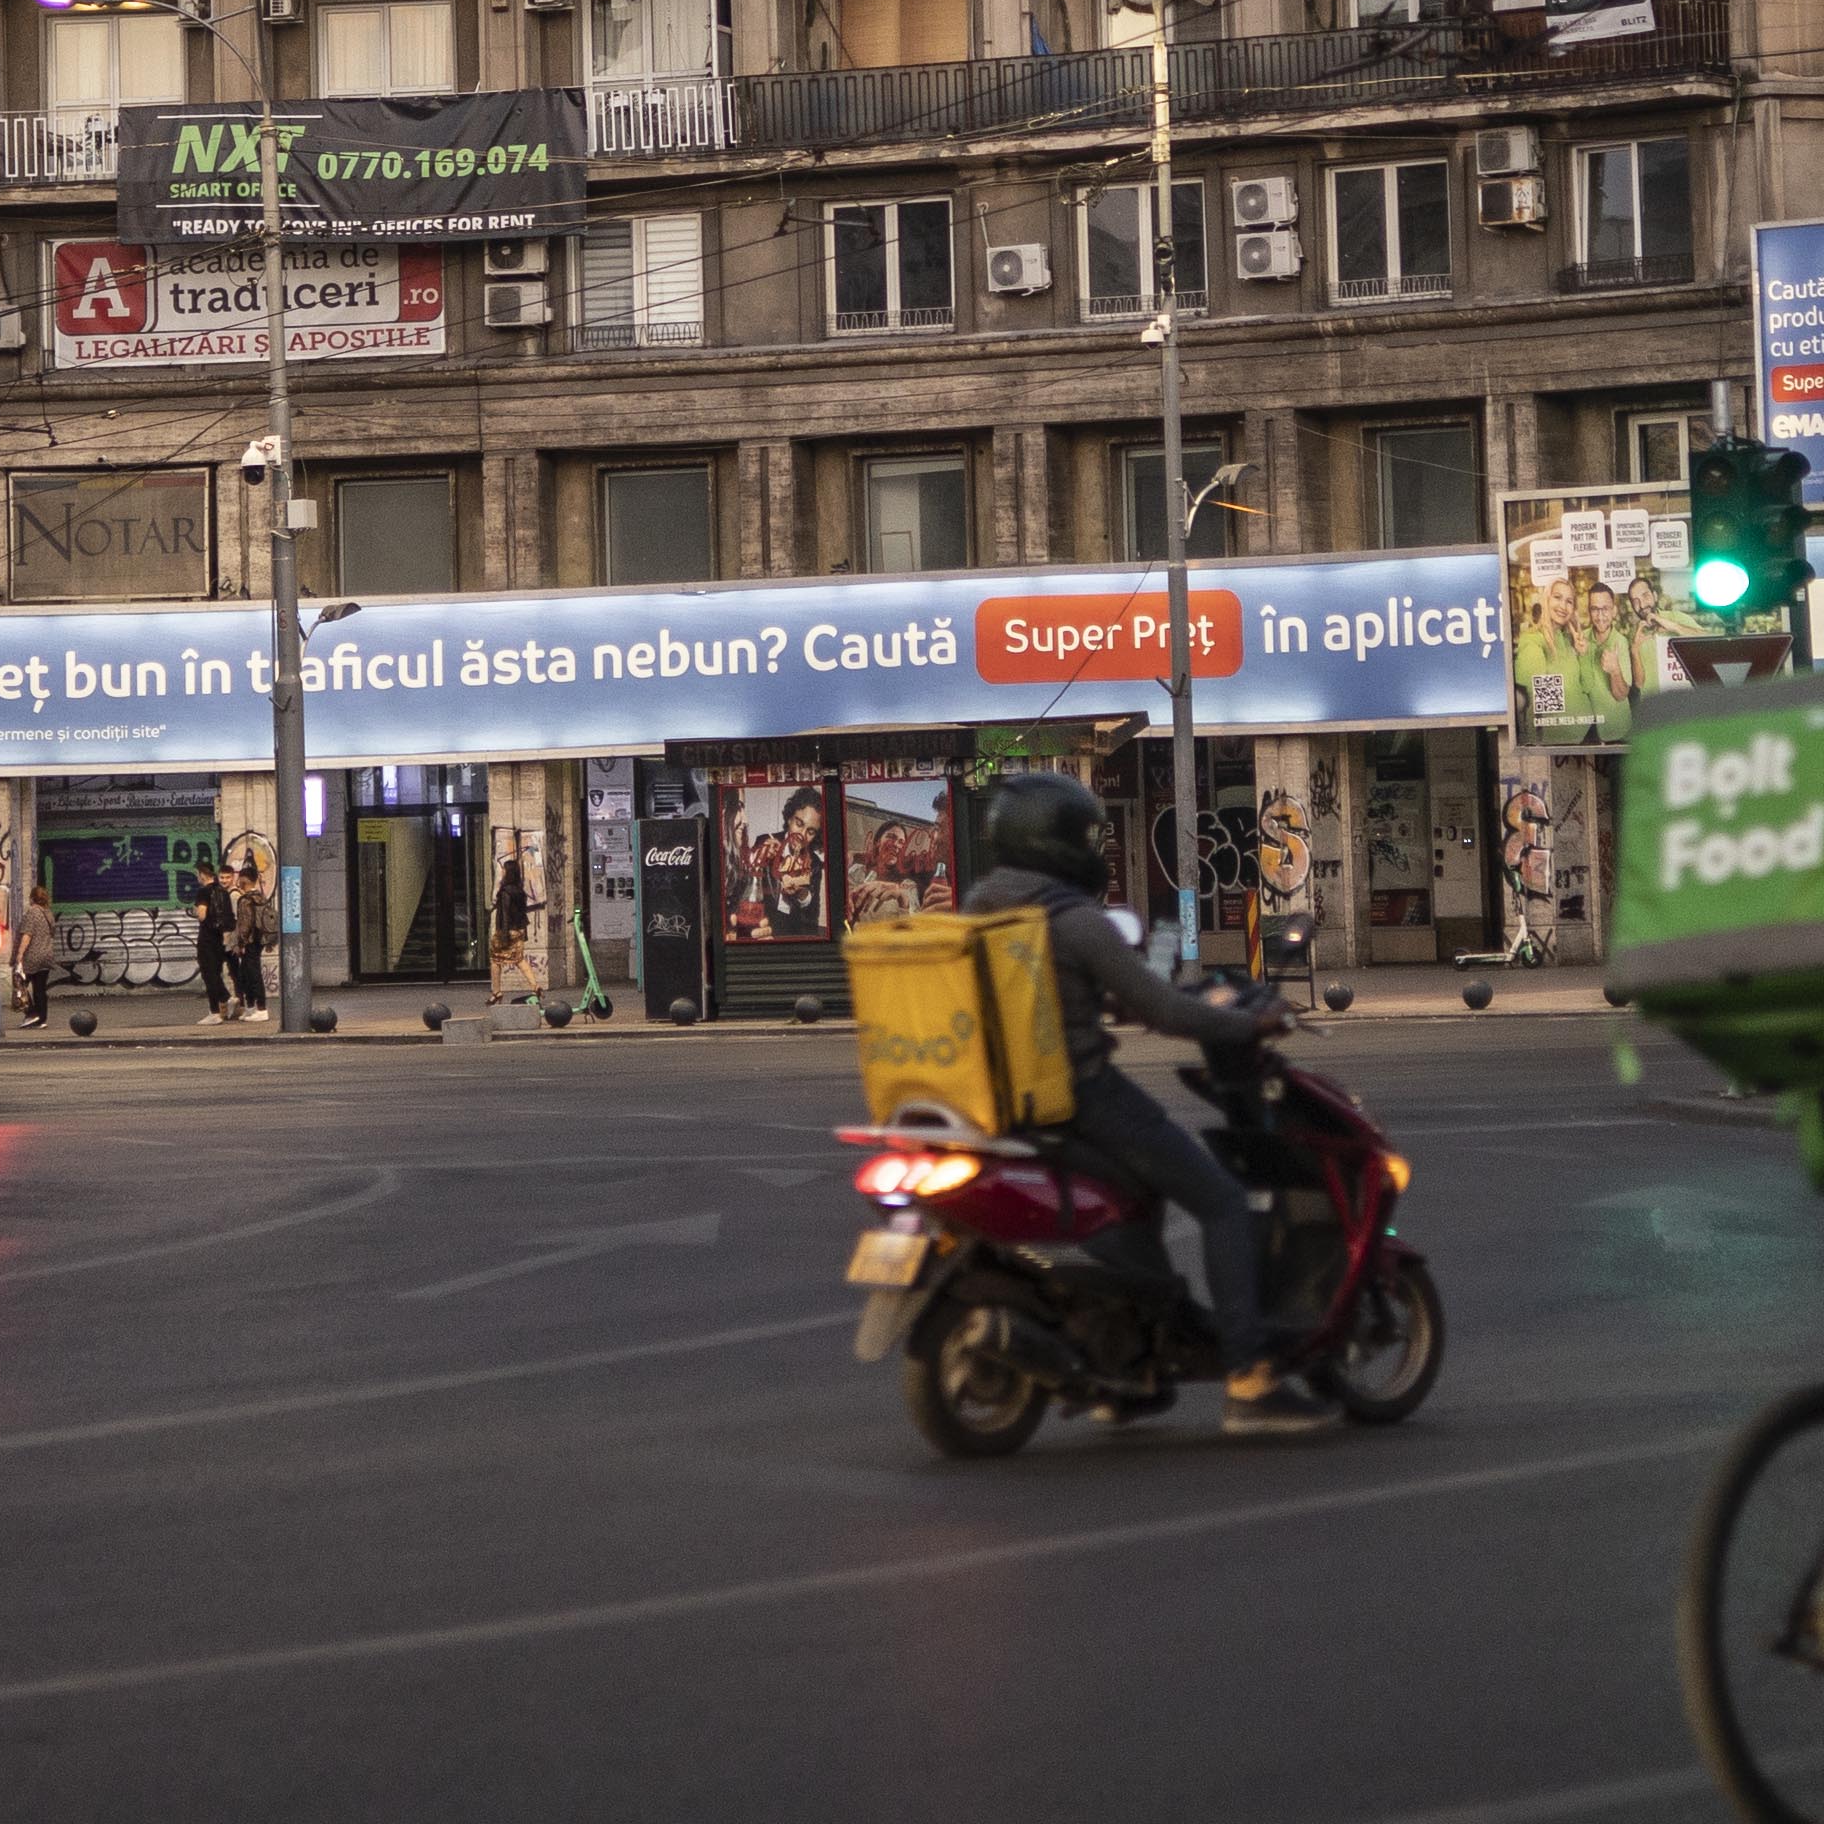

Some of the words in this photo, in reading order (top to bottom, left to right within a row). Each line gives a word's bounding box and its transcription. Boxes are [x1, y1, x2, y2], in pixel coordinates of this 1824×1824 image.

[317, 142, 550, 181] 0770.169.074
[170, 182, 232, 199] SMART
[236, 182, 297, 199] OFCE
[447, 216, 482, 232] FOR
[488, 214, 536, 230] RENT
[339, 245, 380, 268] de
[403, 285, 440, 306] .ro
[75, 331, 246, 360] LEGALIZĂRI
[288, 326, 431, 352] APOSTILE
[1770, 340, 1794, 357] cu
[1004, 617, 1122, 659] Super
[1259, 605, 1309, 654] în
[65, 651, 167, 698] bun
[182, 648, 231, 695] în
[246, 638, 443, 694] taficul
[460, 640, 577, 687] ăsta
[593, 625, 788, 679] nebun?
[803, 616, 957, 673] Caută
[57, 726, 71, 744] și
[73, 723, 130, 744] condiții
[1663, 732, 1796, 816] Bolt
[645, 846, 695, 867] Coca-Cola
